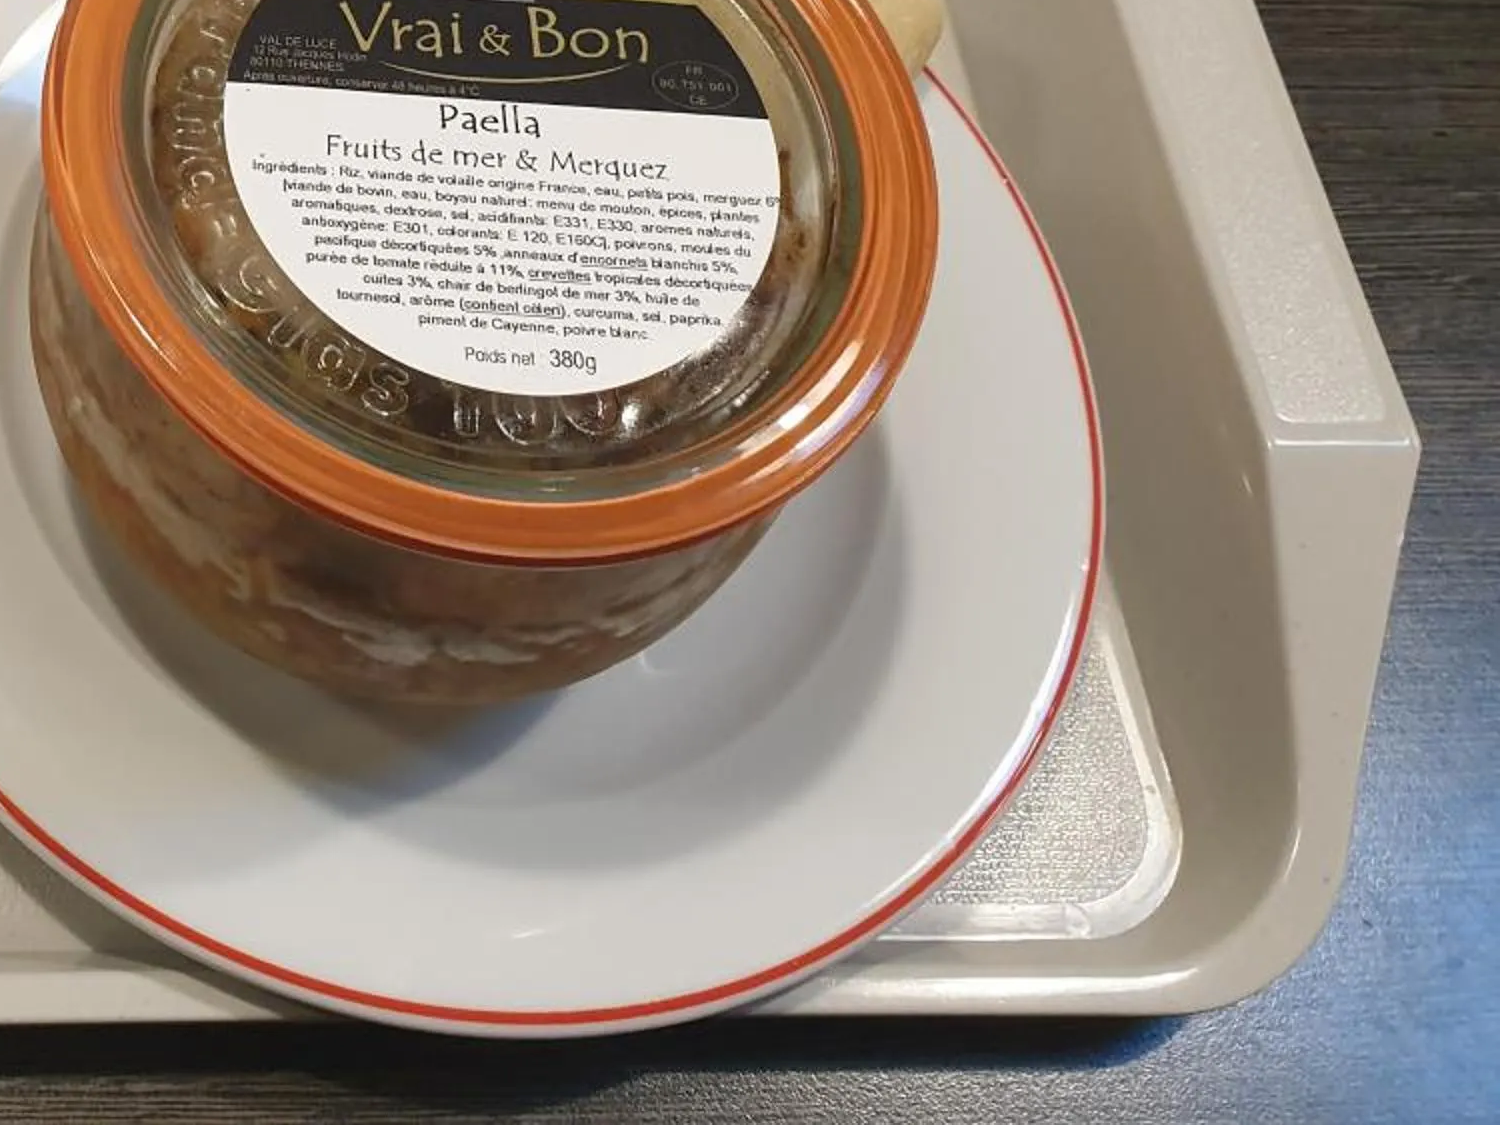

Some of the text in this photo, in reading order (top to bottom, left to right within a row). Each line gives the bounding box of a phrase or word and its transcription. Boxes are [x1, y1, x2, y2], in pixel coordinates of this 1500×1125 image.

[259, 34, 337, 50] VAL DE LUCE
[340, 0, 649, 65] Vrai & Bon
[439, 104, 541, 139] Paella
[326, 133, 402, 162] Fruits
[411, 138, 444, 166] de
[453, 147, 507, 171] mer
[516, 148, 538, 173] &
[252, 158, 327, 177] Ingrédients
[367, 168, 413, 183] viande
[417, 171, 434, 184] de
[335, 181, 353, 195] de
[577, 200, 596, 213] de
[315, 234, 376, 250] pacifique
[651, 256, 708, 272] blanchis
[680, 242, 731, 256] moules
[734, 244, 752, 258] du
[351, 252, 369, 269] de
[372, 254, 420, 270] tomate
[527, 265, 592, 285] crevettes
[594, 267, 661, 288] tropicales
[362, 273, 404, 287] cuites
[475, 280, 494, 294] de
[562, 284, 581, 300] de
[584, 290, 612, 302] mer
[681, 294, 701, 308] de
[417, 311, 467, 328] piment
[469, 316, 489, 330] de
[465, 346, 598, 375] Poids net 380g
